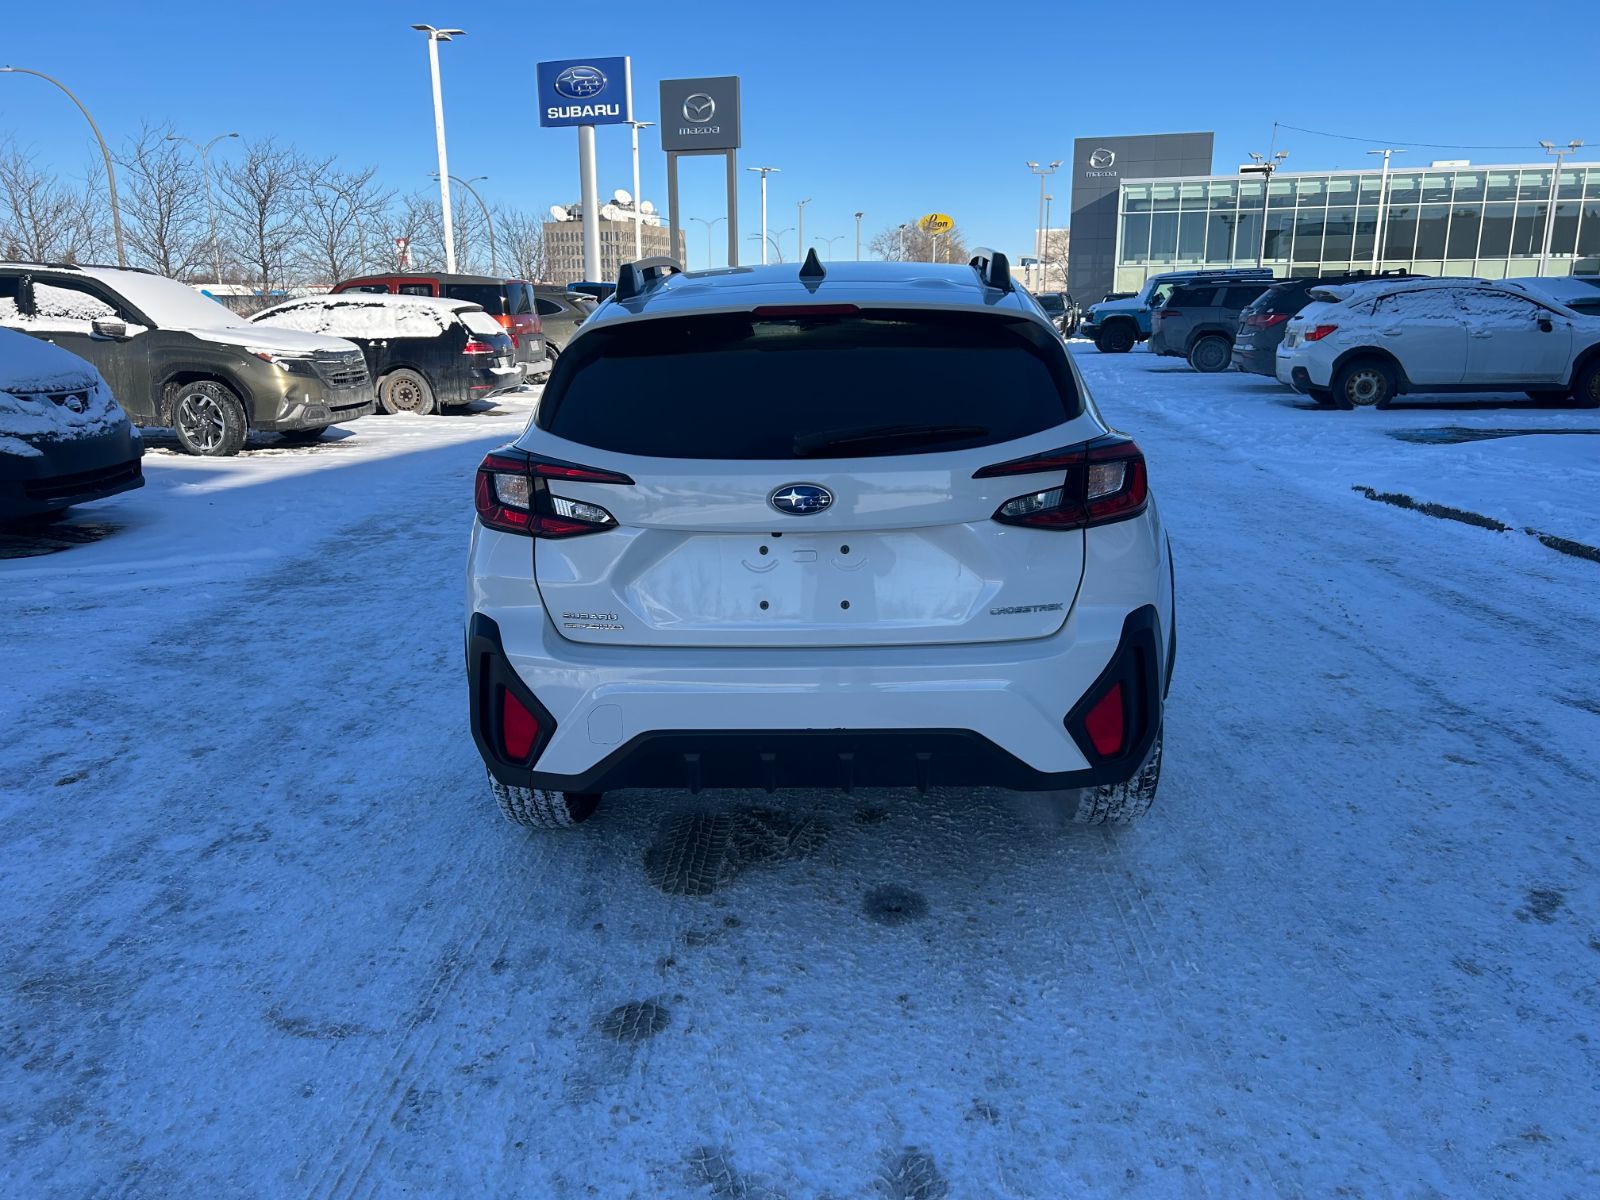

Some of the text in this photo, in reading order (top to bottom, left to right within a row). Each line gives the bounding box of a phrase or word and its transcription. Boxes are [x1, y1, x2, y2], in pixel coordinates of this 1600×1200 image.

[547, 103, 620, 119] SUBARU
[562, 611, 619, 621] SUBARU
[990, 602, 1064, 616] CROSSTREK
